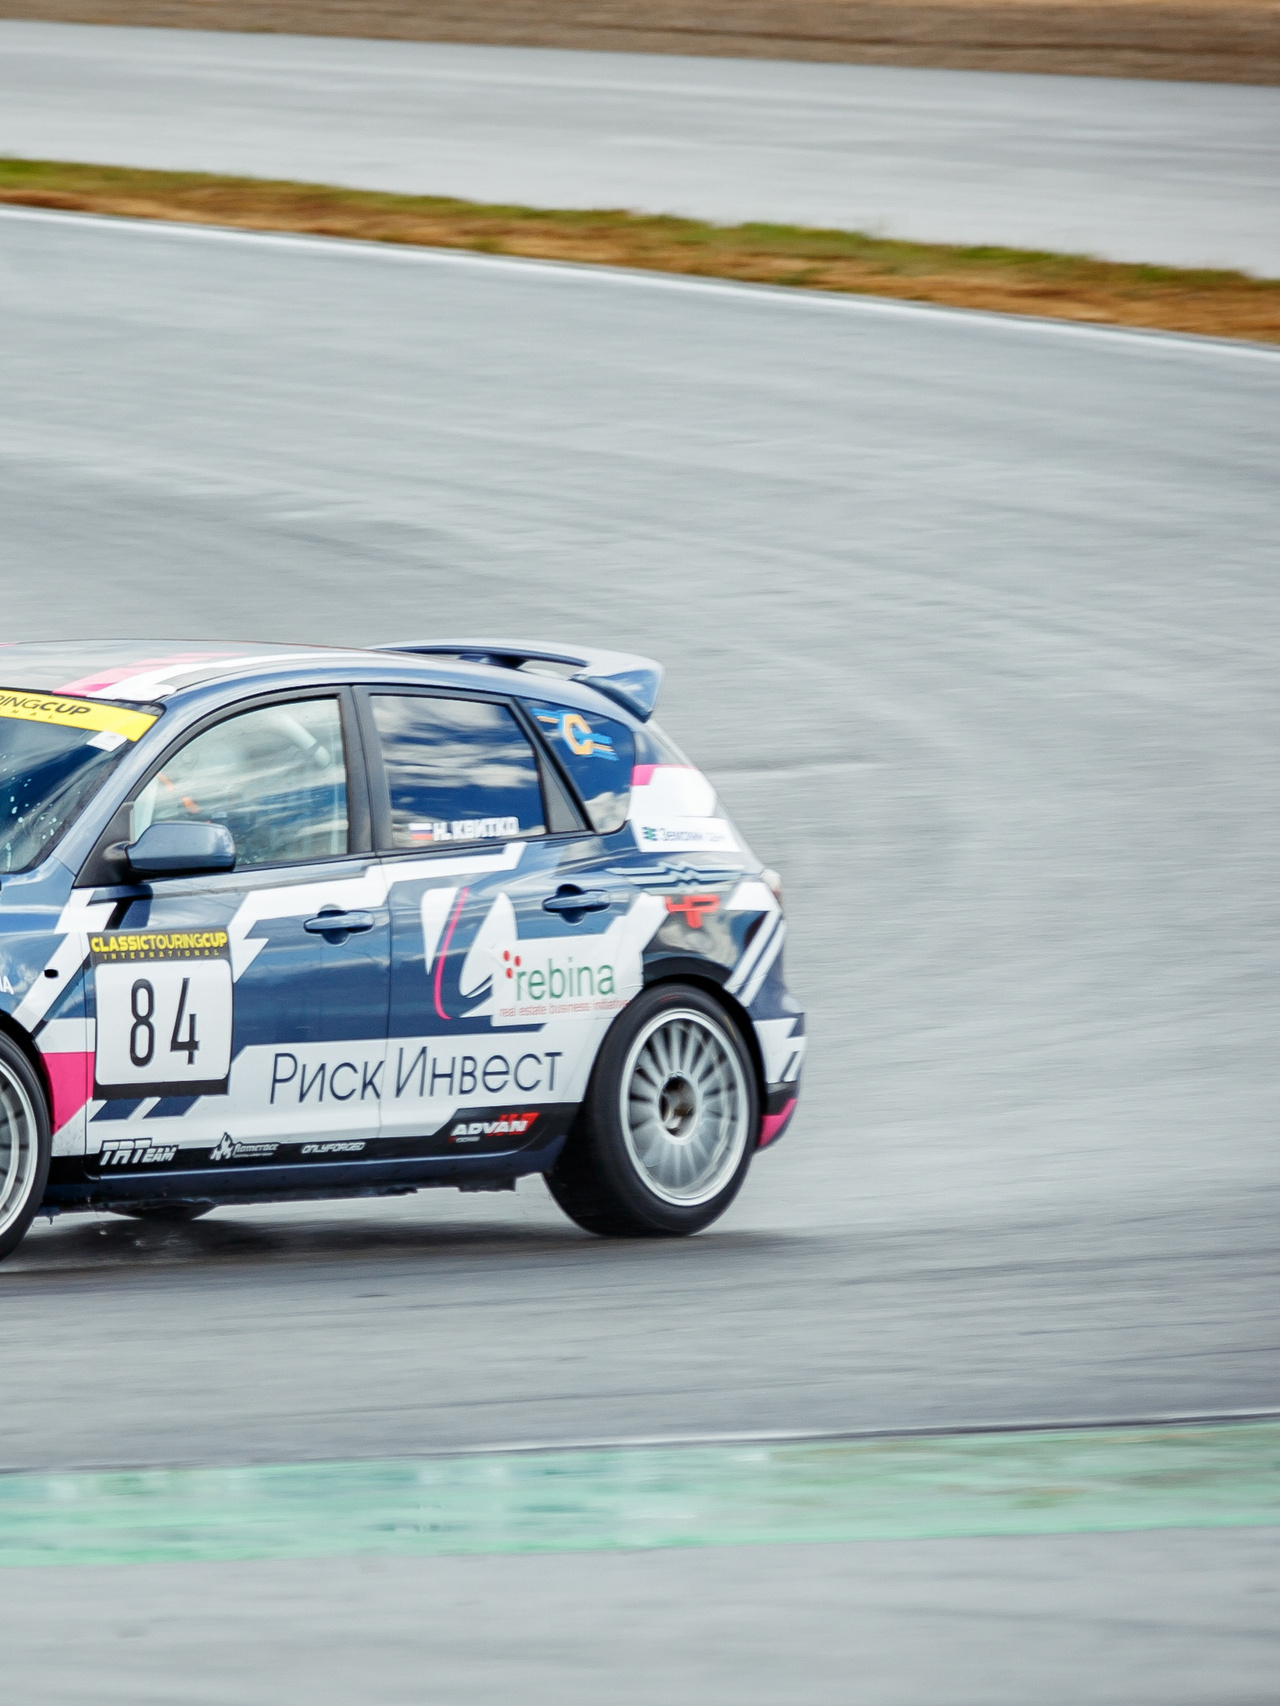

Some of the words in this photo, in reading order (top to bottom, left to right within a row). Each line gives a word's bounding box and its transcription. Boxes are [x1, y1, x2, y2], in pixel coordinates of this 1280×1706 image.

[90, 931, 228, 953] CLASSICTOURINGCUP
[103, 949, 220, 961] INTERNATIONAL
[516, 956, 616, 1001] rebina
[129, 976, 201, 1068] 84
[269, 1052, 386, 1105] Риск
[394, 1045, 564, 1099] Инвест
[449, 1120, 529, 1137] ADVAN
